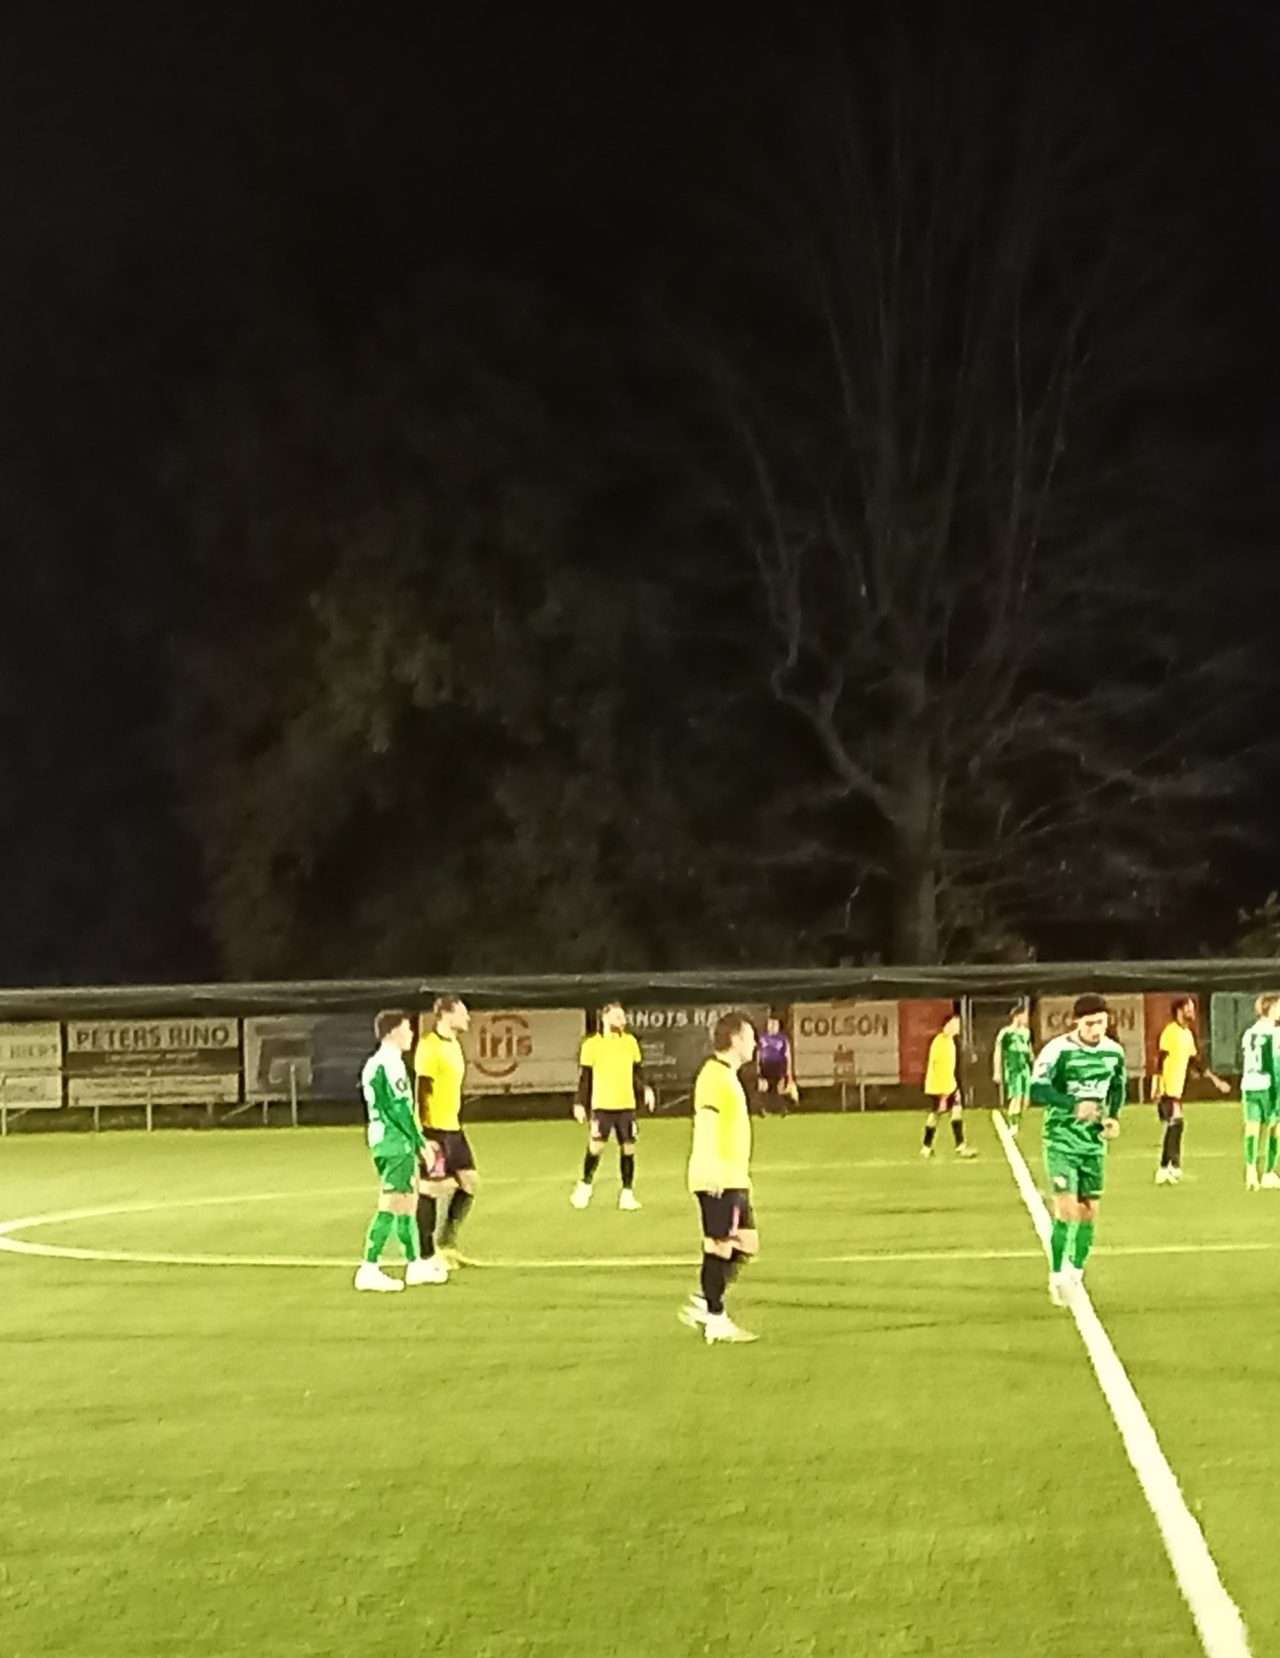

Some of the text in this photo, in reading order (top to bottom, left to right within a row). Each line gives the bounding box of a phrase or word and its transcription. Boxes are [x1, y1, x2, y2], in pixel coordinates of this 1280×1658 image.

[76, 1024, 230, 1050] PETERS RINO
[800, 1013, 889, 1037] COLSON
[478, 1025, 534, 1059] iris
